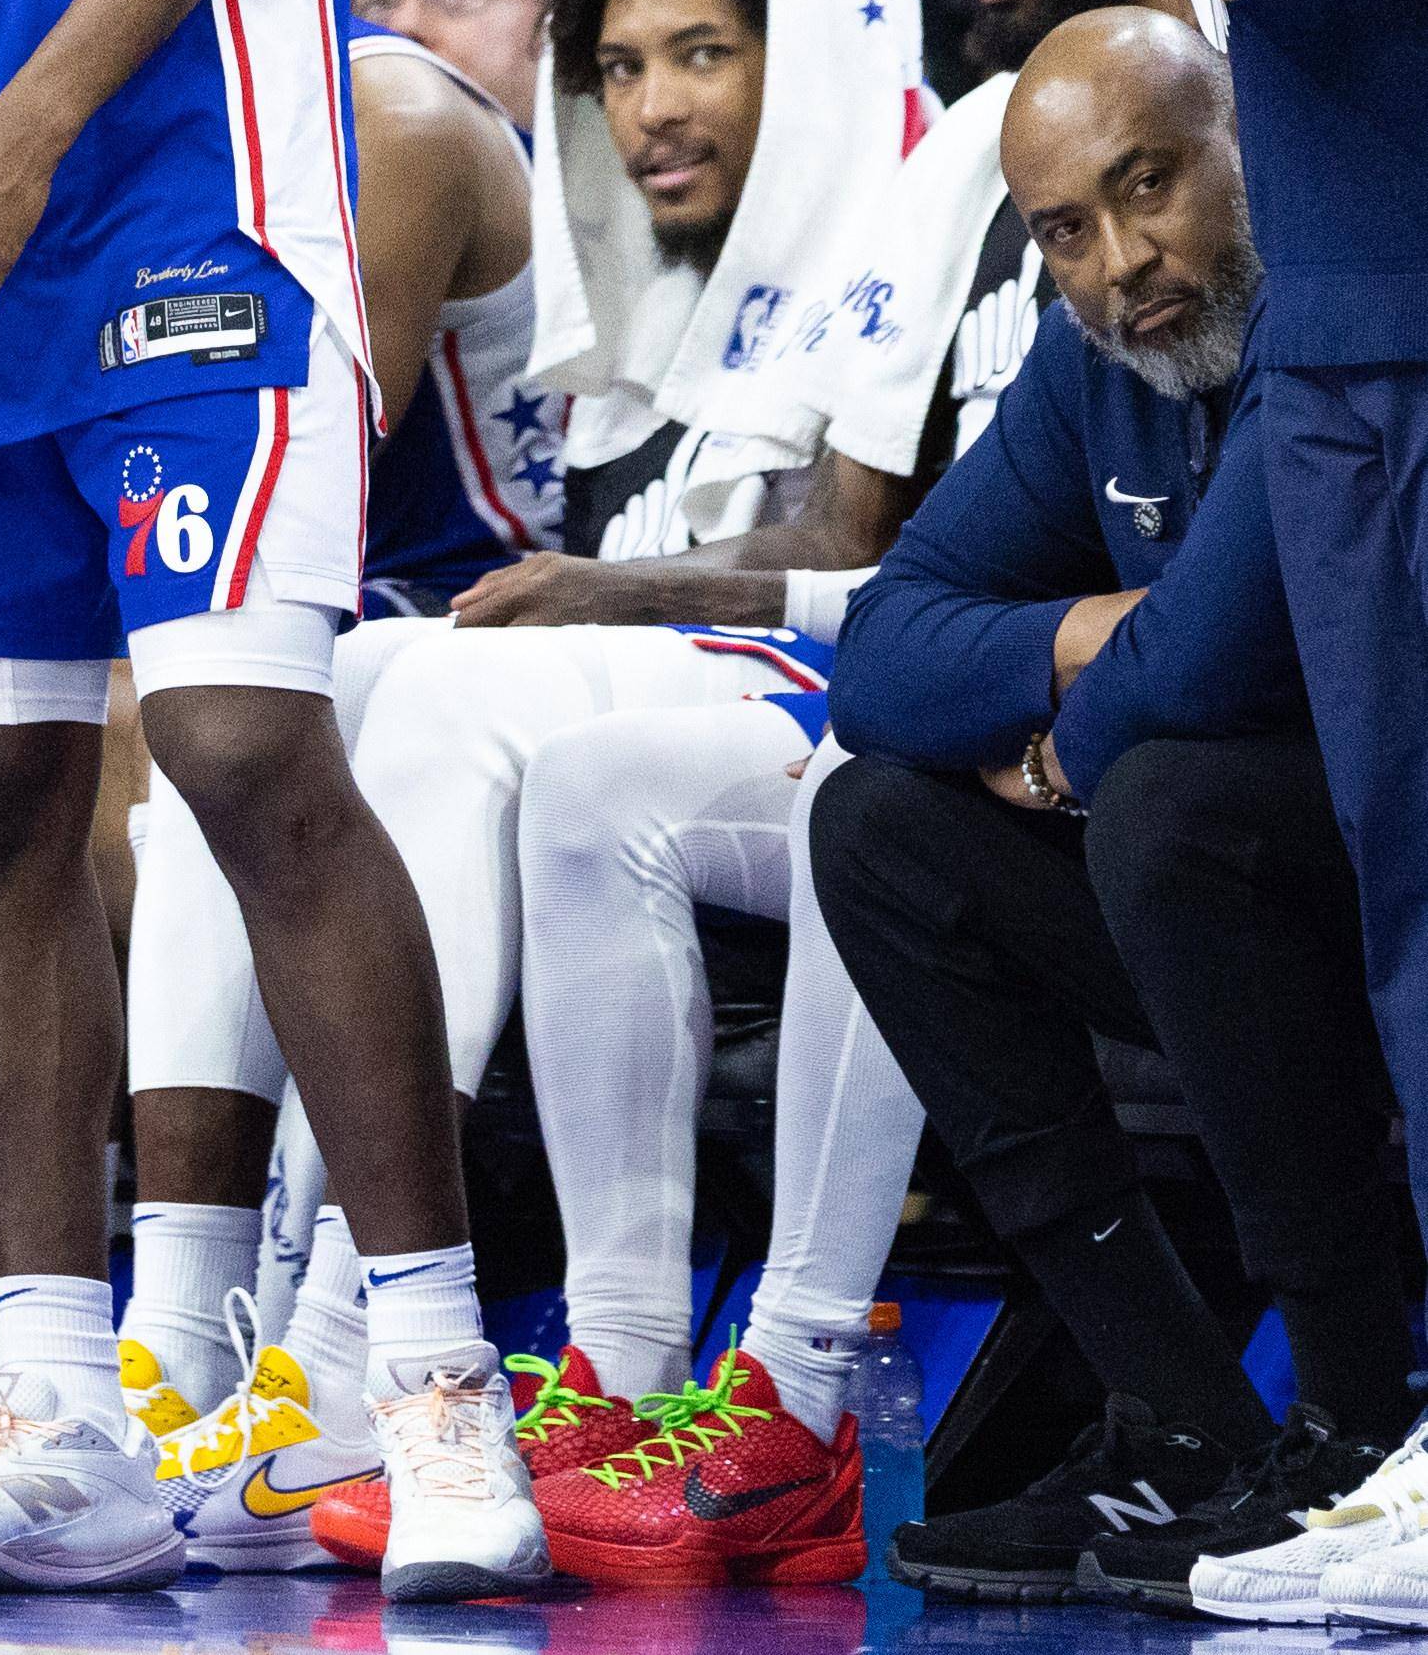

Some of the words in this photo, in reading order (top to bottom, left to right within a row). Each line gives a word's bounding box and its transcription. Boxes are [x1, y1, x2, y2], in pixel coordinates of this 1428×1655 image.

[194, 259, 229, 279] Love
[150, 315, 162, 327] 48
[118, 483, 214, 577] 76
[1087, 1480, 1178, 1533] N
